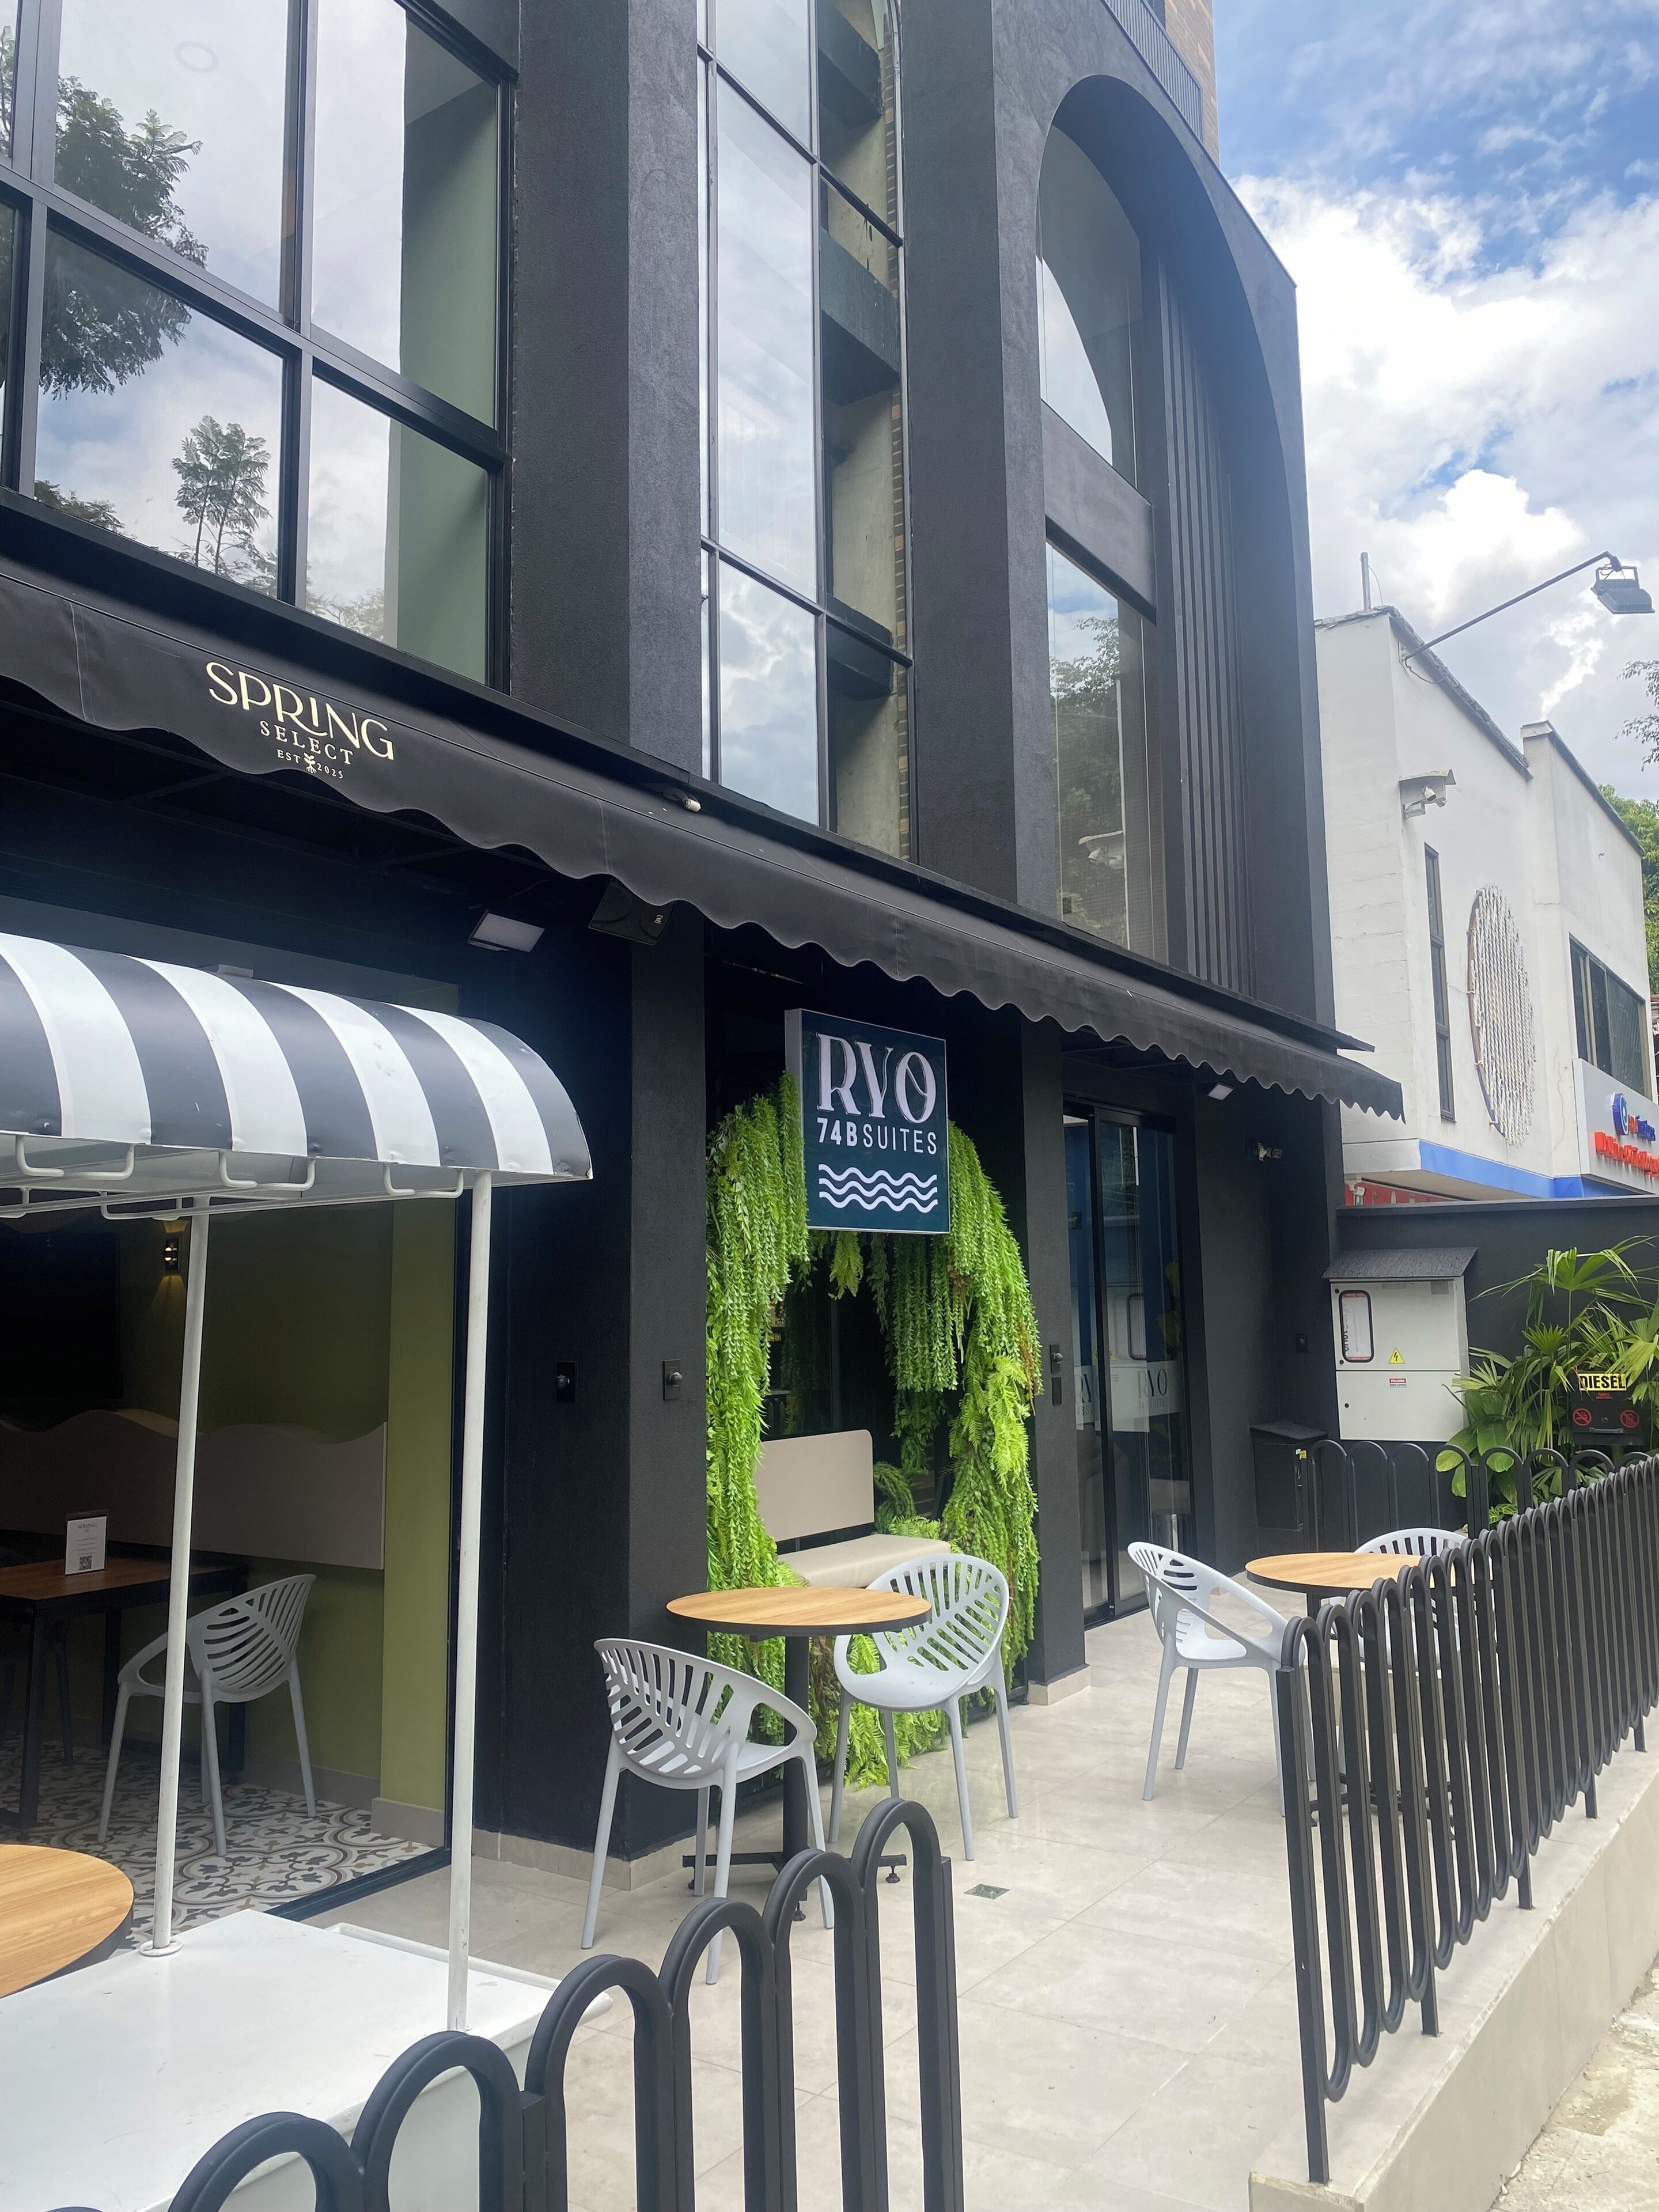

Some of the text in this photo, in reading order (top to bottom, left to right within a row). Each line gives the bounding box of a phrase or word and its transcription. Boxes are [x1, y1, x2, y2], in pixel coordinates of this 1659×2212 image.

[206, 661, 394, 760] SPRING
[259, 720, 354, 765] SELECT
[276, 749, 344, 779] EST 2025
[816, 1032, 937, 1123] RYO
[1579, 1376, 1626, 1389] DIESEL
